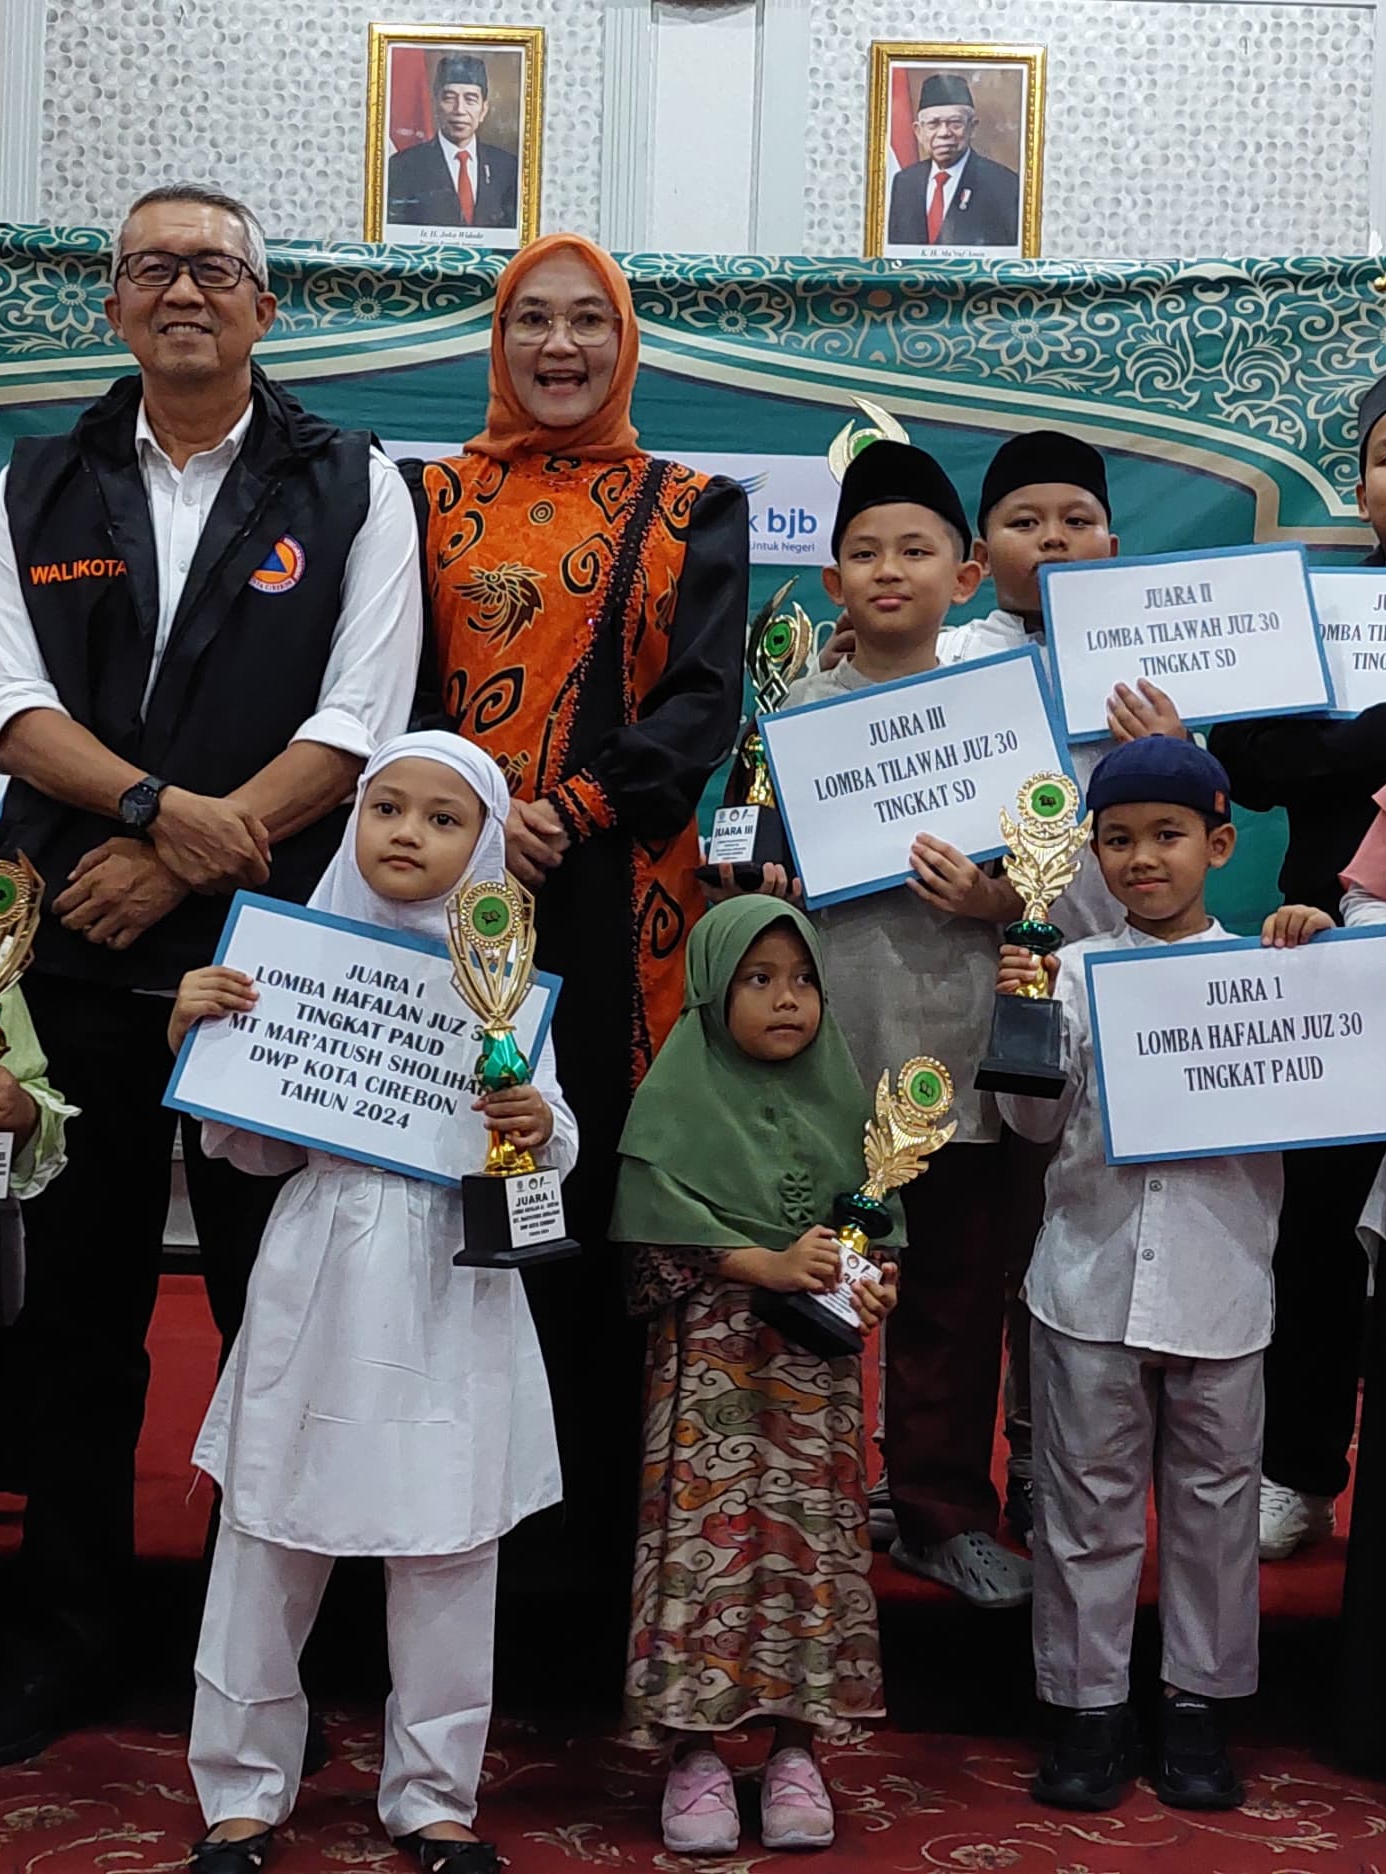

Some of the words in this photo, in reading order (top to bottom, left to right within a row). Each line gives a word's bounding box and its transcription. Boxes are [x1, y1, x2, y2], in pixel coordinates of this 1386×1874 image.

[768, 507, 817, 539] bjb
[781, 542, 815, 554] Negeri
[30, 559, 127, 585] WALIKOTA
[1144, 586, 1196, 610] JUARA
[1200, 583, 1213, 604] II
[1087, 627, 1144, 652] LOMBA
[1147, 616, 1222, 646] TILAWAH
[1226, 614, 1257, 636] JUZ
[1259, 612, 1280, 633] 30
[1318, 623, 1362, 642] OMBA
[1139, 651, 1211, 677] TINGKAT
[1215, 647, 1237, 669] SD
[869, 712, 925, 747] JUARA
[928, 706, 947, 730] III
[813, 771, 876, 802] LOMBA
[876, 748, 959, 784] TILAWAH
[962, 736, 993, 764] JUZ
[997, 730, 1018, 754] 30
[874, 784, 952, 824] TINGKAT
[955, 779, 977, 804] SD
[715, 827, 742, 837] JUARA
[345, 963, 410, 996] JUARA
[416, 981, 425, 999] I
[1206, 981, 1268, 1006] JUARA
[255, 965, 325, 999] LOMBA
[332, 985, 423, 1025] HAFALAN
[427, 1011, 467, 1037] JUZ
[229, 1012, 261, 1034] MT
[265, 1021, 382, 1067] MAR'ATUSH
[295, 1002, 384, 1040] TINGKAT
[388, 1027, 445, 1057] PAUD
[1136, 1029, 1202, 1056] LOMBA
[1207, 1020, 1296, 1049] HAFALAN
[1300, 1014, 1335, 1041] JUZ
[1339, 1012, 1363, 1036] 30
[249, 1044, 299, 1070] DWP
[303, 1060, 358, 1088] KOTA
[364, 1077, 458, 1116] CIREBON
[1184, 1063, 1268, 1092] TINGKAT
[1271, 1055, 1324, 1085] PAUD
[278, 1079, 349, 1112] TAHUN
[354, 1099, 411, 1129] 2024
[516, 1192, 548, 1207] JUARA
